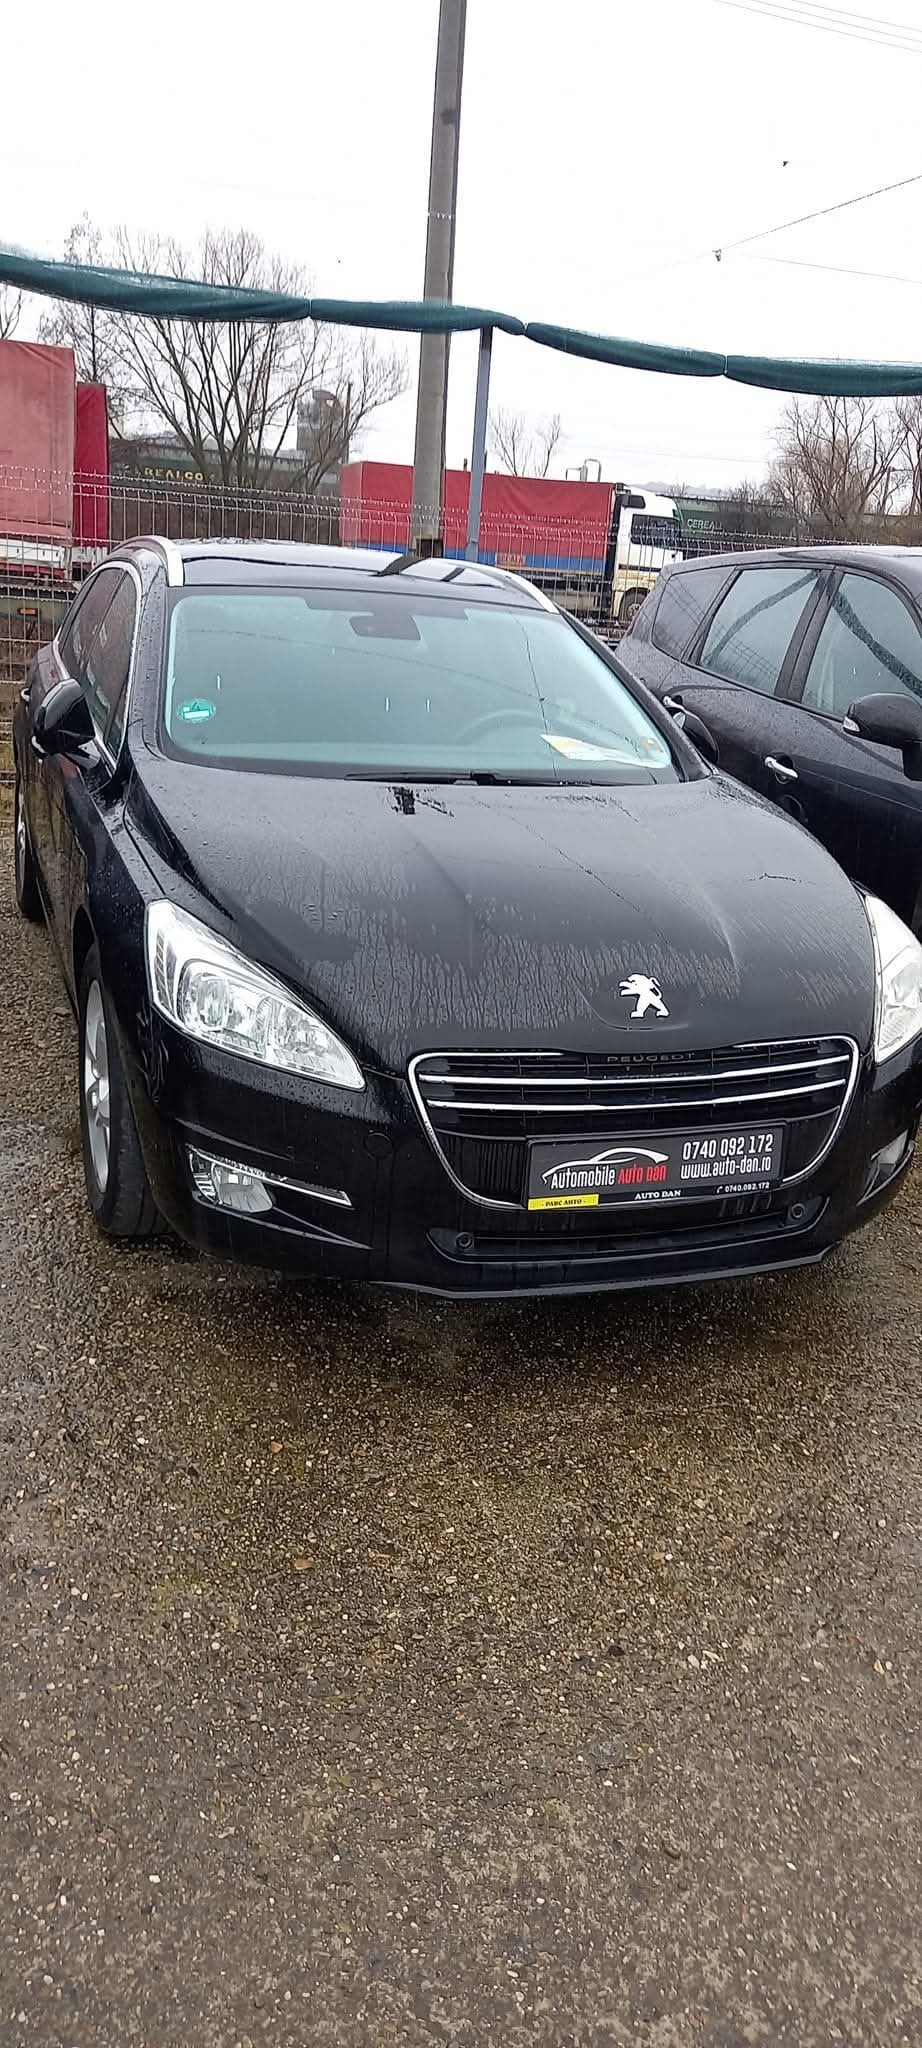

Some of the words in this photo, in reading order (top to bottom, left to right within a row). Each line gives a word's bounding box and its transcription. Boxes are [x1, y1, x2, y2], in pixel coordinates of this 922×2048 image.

[607, 1052, 695, 1063] PEUGEOT
[682, 1141, 716, 1161] 0740
[720, 1137, 745, 1157] 092
[749, 1133, 774, 1154] 172
[680, 1155, 772, 1180] www.auto-dan.ro
[550, 1165, 616, 1190] Automobile
[725, 1181, 770, 1193] 0740.092.172
[634, 1190, 660, 1201] AUTO
[661, 1189, 681, 1200] DAN
[563, 1198, 582, 1206] AUTO
